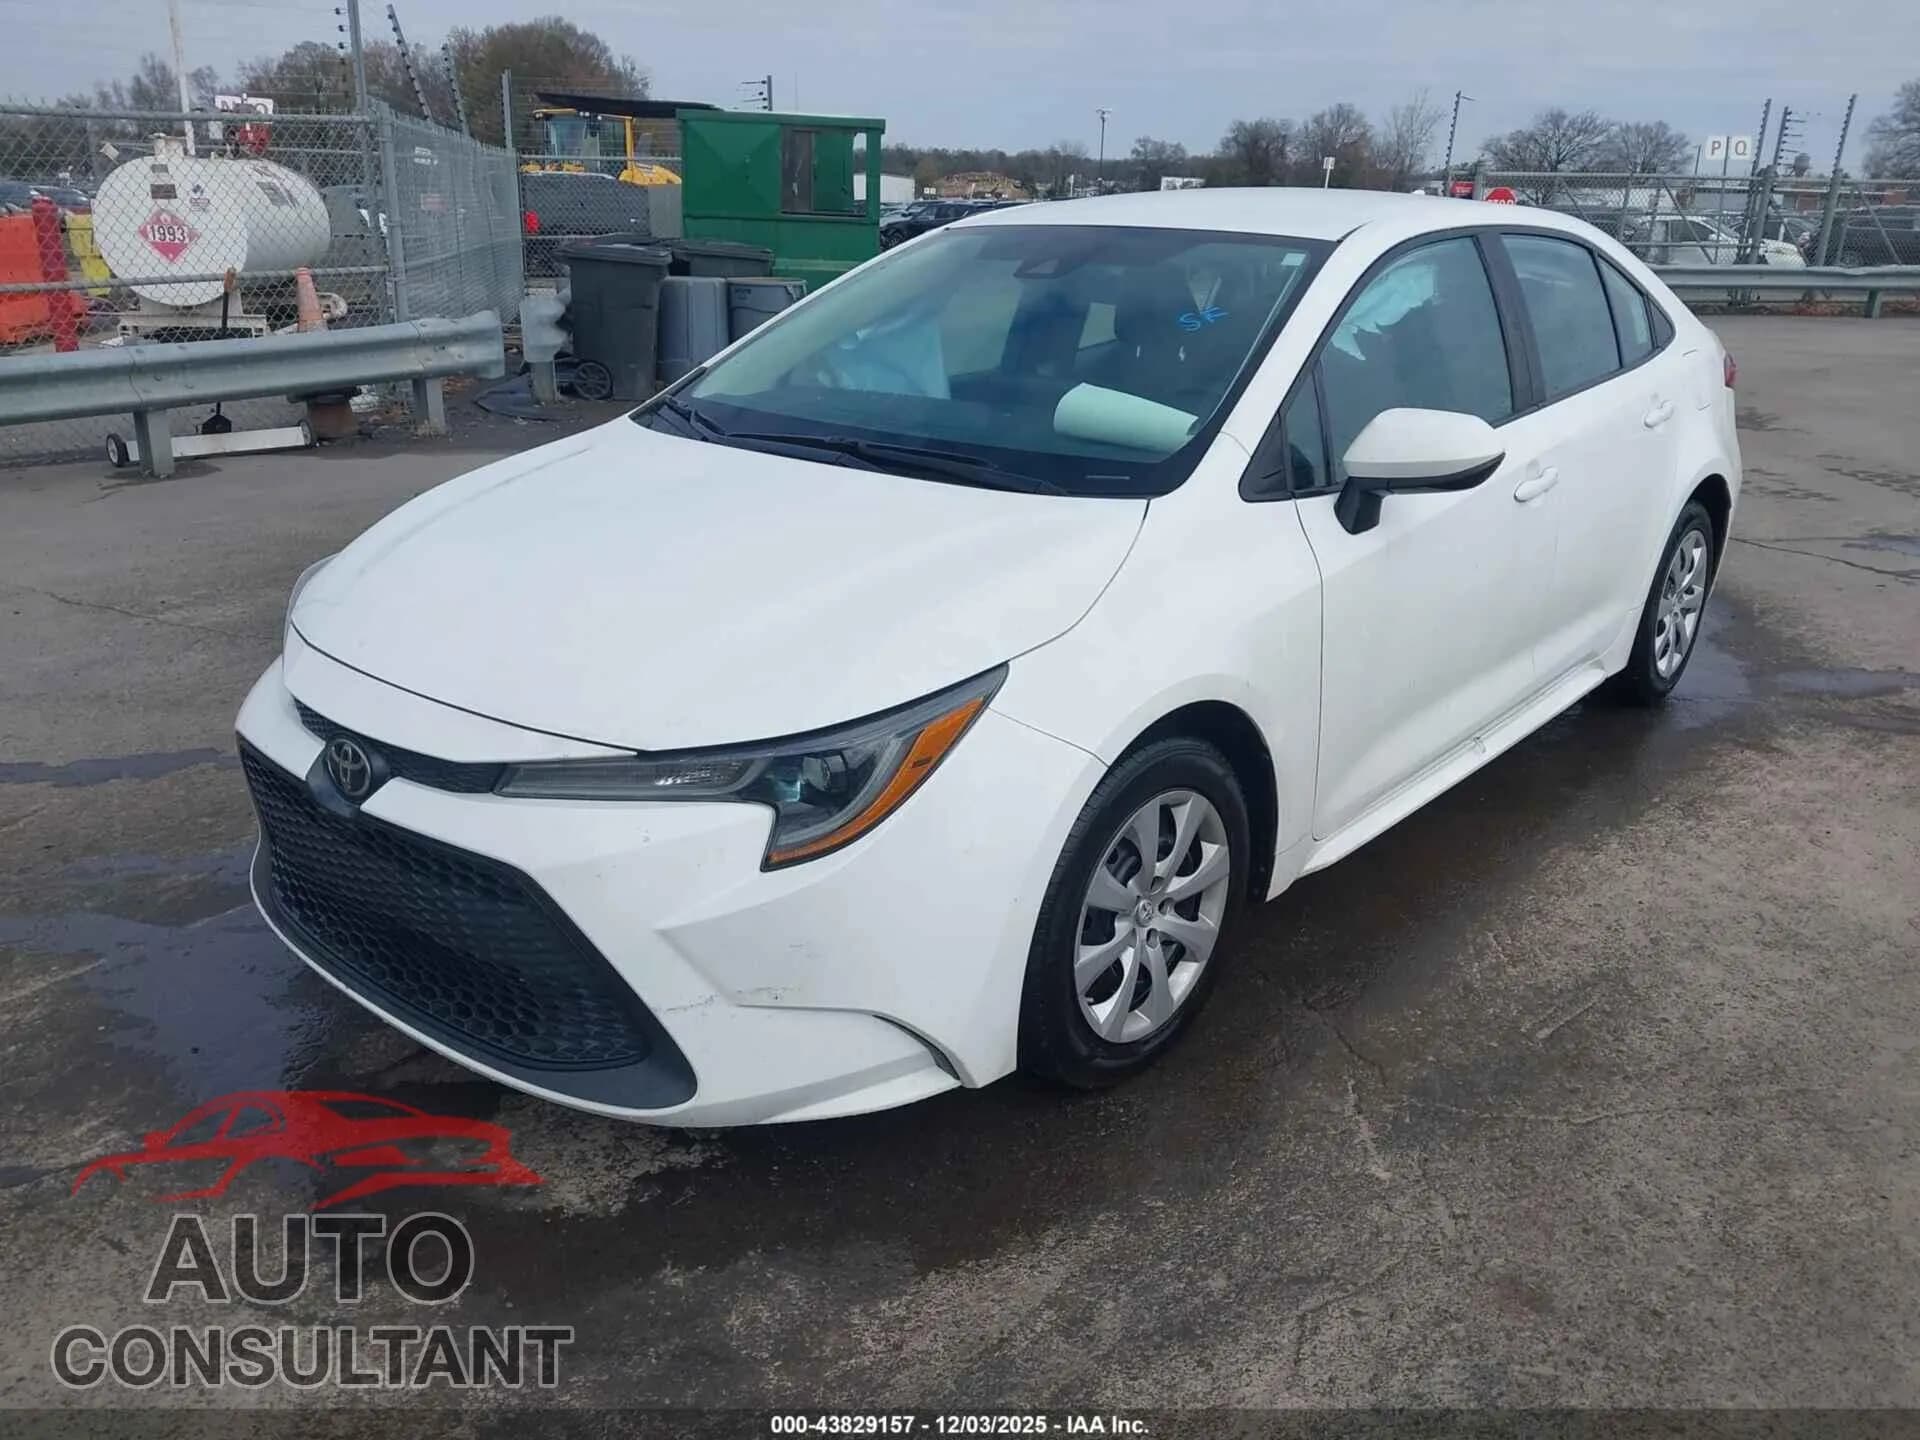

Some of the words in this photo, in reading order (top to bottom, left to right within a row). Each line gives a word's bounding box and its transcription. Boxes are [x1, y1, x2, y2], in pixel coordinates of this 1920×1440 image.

[1711, 140, 1721, 156] P
[1735, 140, 1747, 156] Q
[150, 225, 186, 243] 1993
